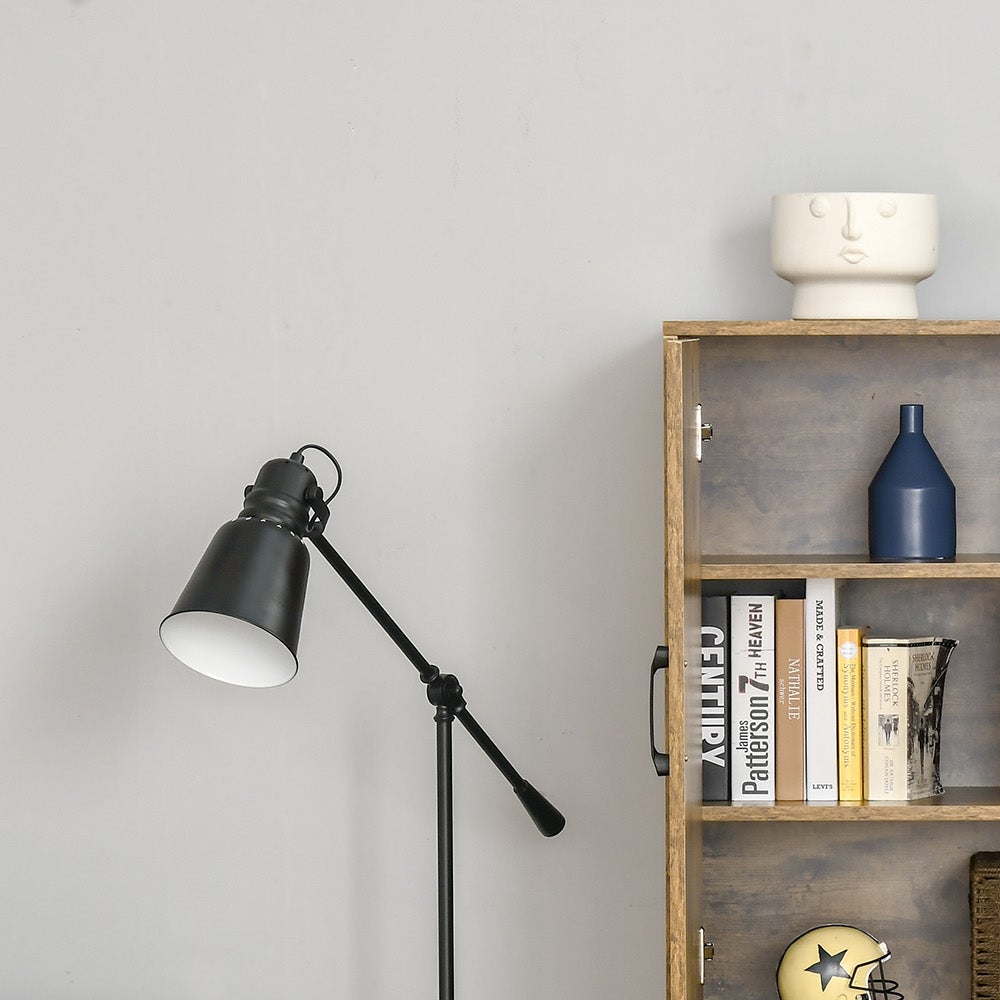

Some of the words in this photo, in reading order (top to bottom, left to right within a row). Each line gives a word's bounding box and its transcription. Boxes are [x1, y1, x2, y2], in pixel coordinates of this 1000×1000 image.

[747, 603, 763, 658] HEAVEN
[815, 599, 824, 632] MADE
[815, 633, 824, 641] &
[787, 658, 801, 720] NATHALIE
[815, 643, 824, 692] CRAFTED
[883, 665, 891, 703] HOLMES
[891, 659, 899, 708] SHERLOCK
[735, 720, 749, 753] James
[741, 696, 769, 795] Patterson
